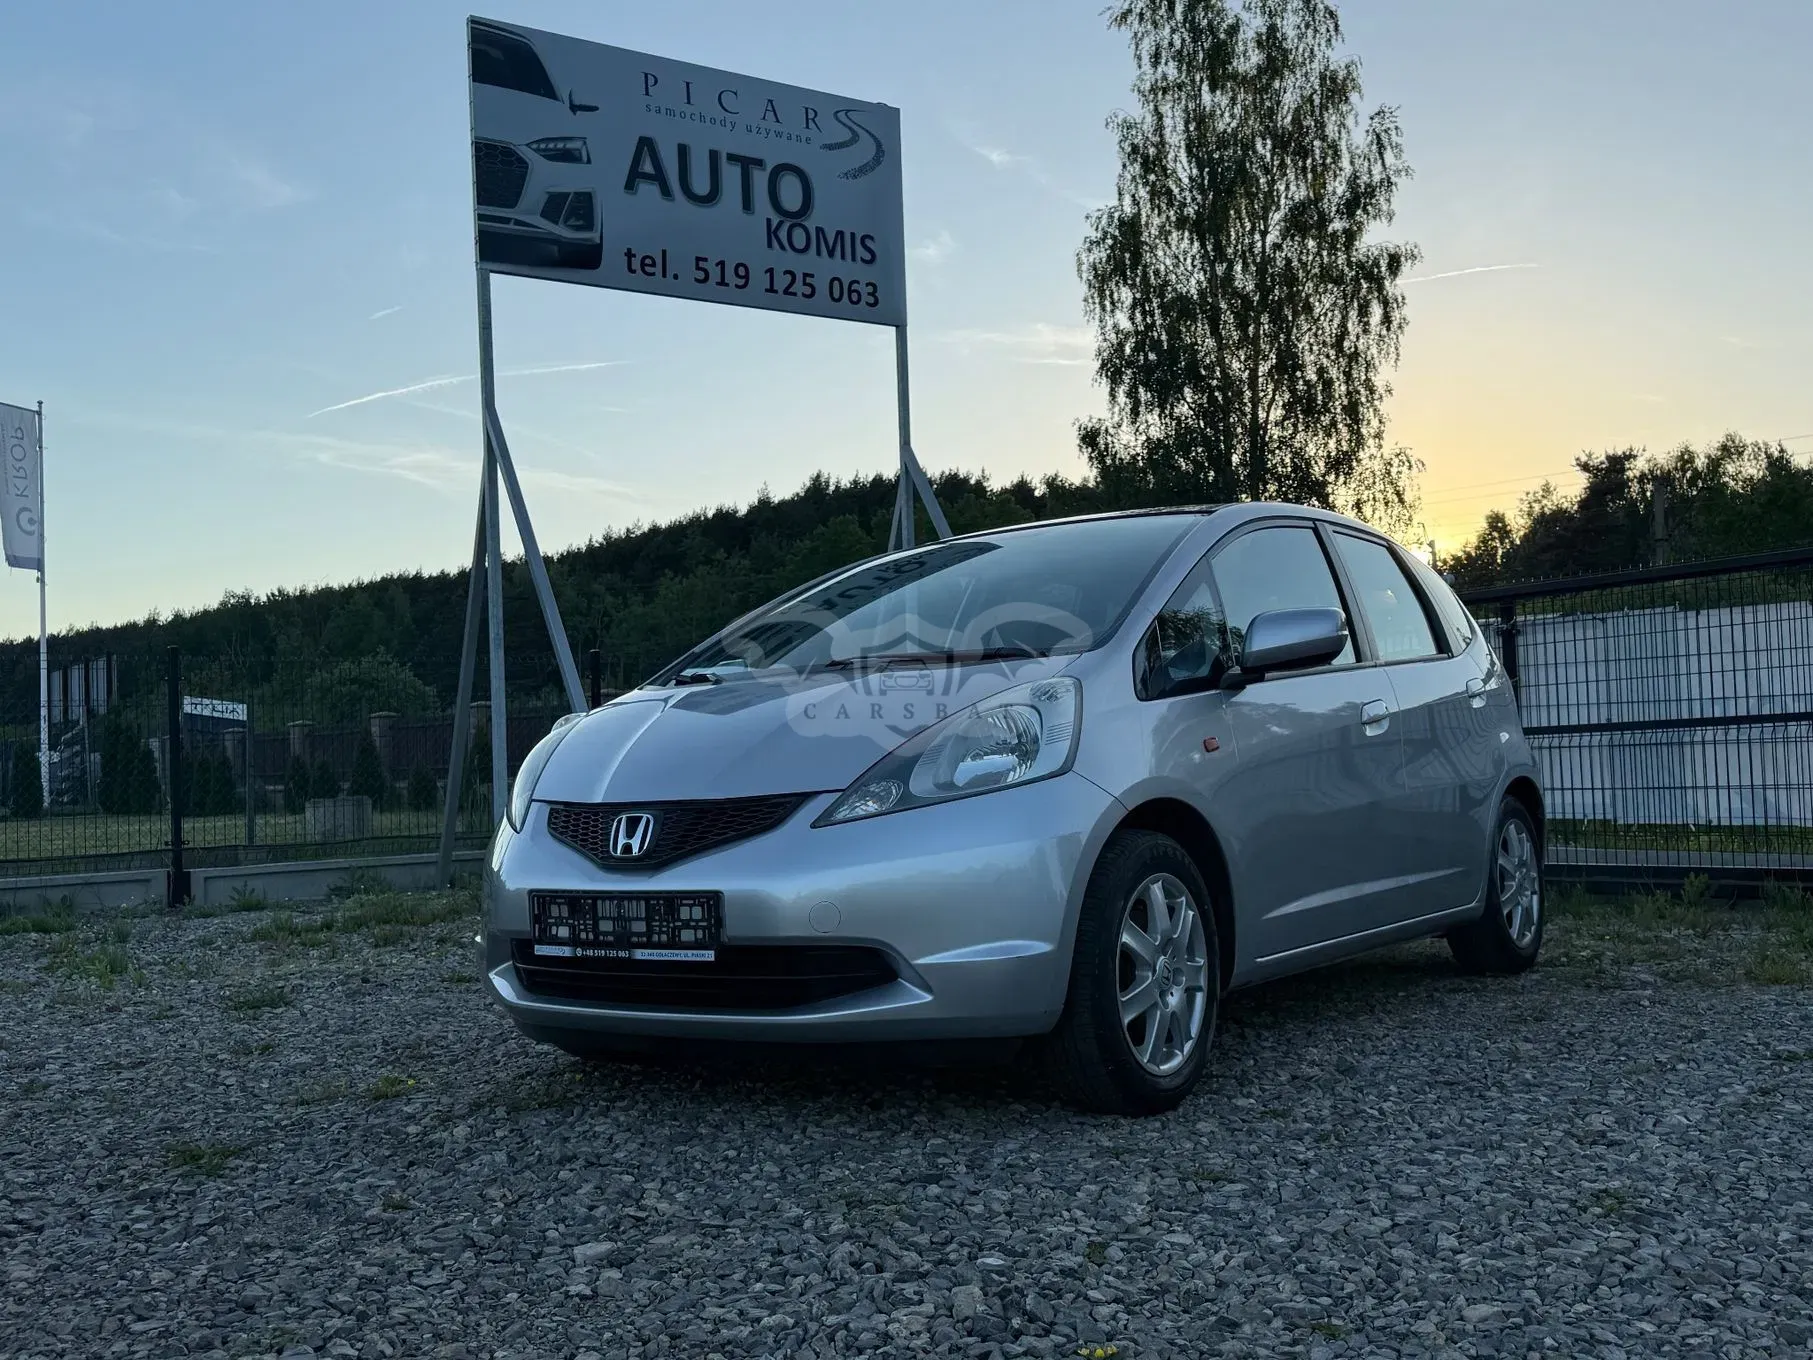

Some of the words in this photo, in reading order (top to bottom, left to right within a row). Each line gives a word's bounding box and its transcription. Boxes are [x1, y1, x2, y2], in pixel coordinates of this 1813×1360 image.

[645, 102, 737, 132] samochody
[745, 122, 812, 145] używane
[624, 135, 814, 222] AUTO
[765, 217, 877, 265] KOMIS
[624, 247, 679, 281] tel.
[693, 255, 750, 290] 519
[764, 266, 816, 299] 125
[828, 276, 880, 308] 063
[617, 950, 630, 958] 063
